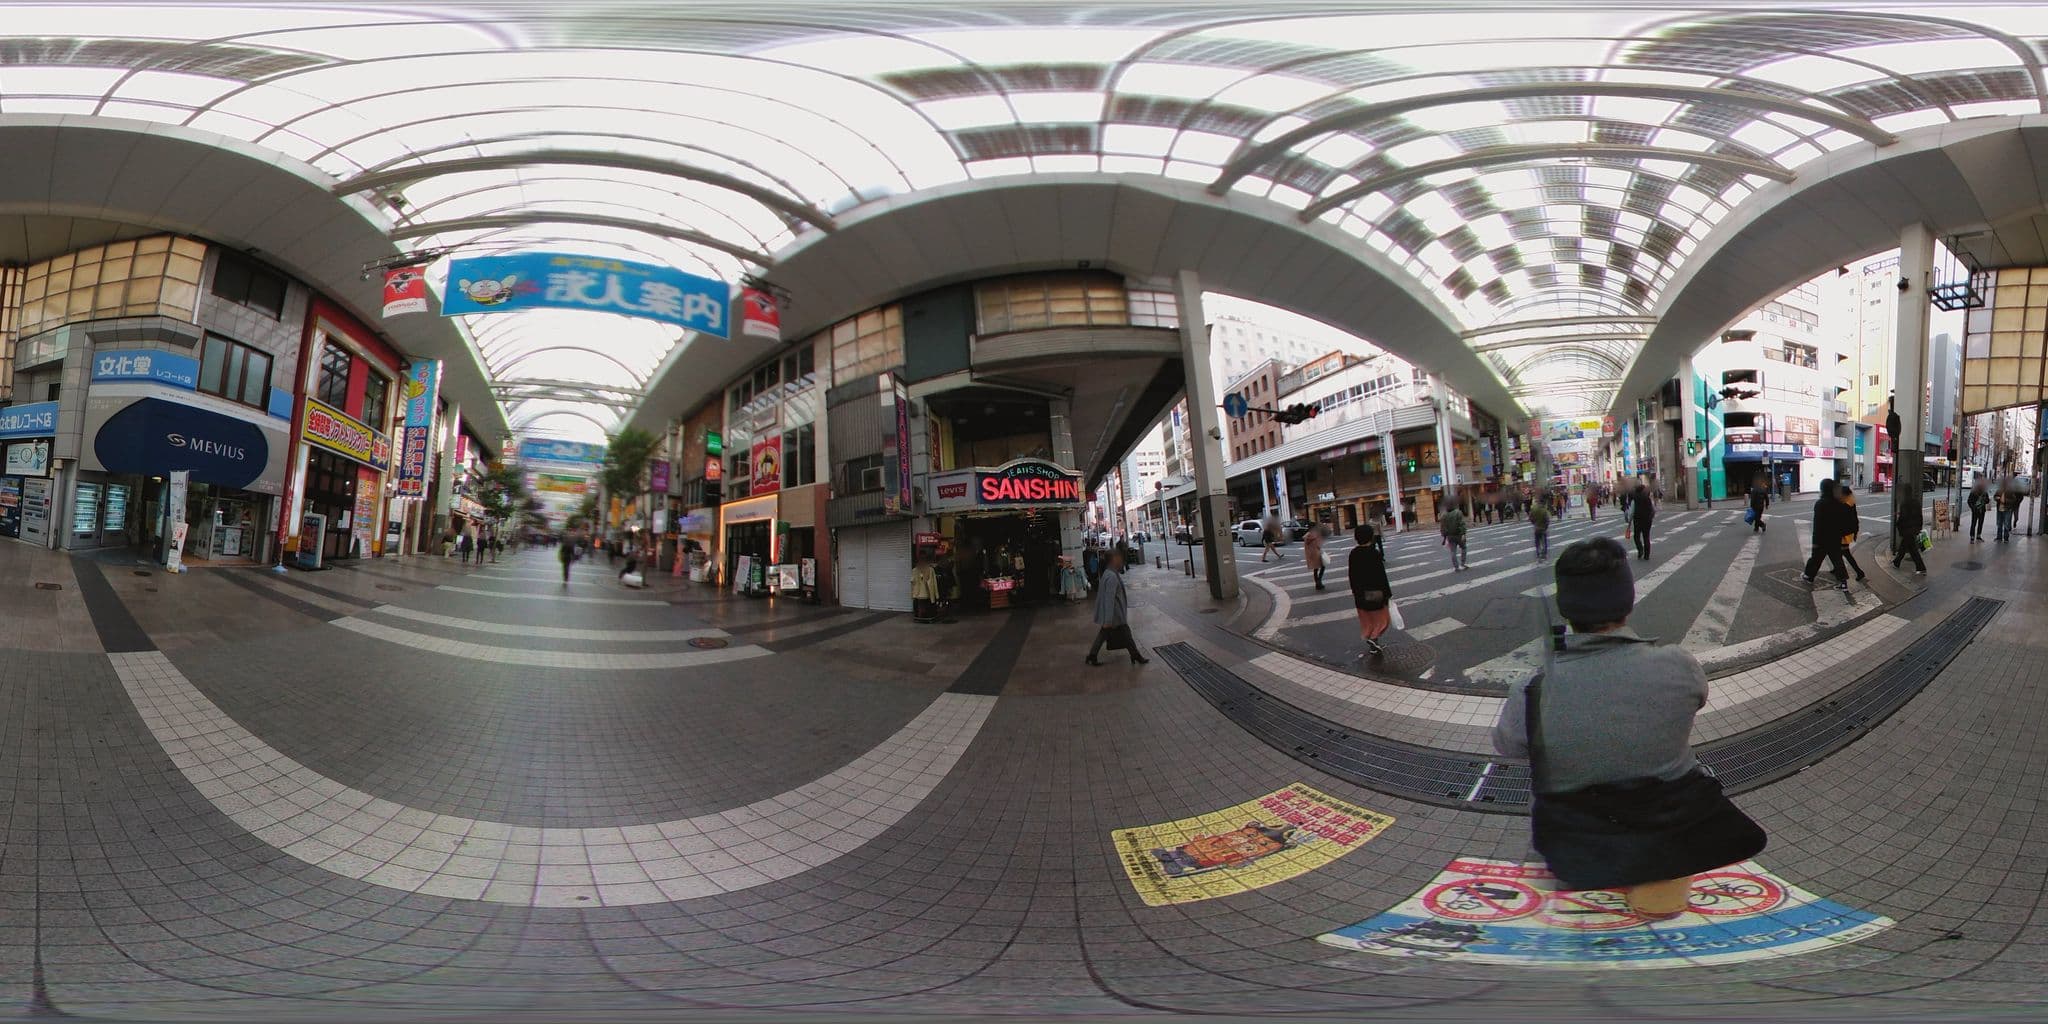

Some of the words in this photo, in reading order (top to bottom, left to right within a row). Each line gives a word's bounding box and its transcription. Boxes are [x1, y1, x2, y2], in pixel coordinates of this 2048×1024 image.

[98, 356, 152, 376] 文化堂
[156, 369, 192, 384] レコード店
[189, 437, 245, 461] MEVIUS
[1036, 466, 1060, 480] SHOP
[981, 476, 1079, 501] SANSHIN
[1259, 797, 1359, 846] 特別強化地域
[1276, 790, 1374, 835] 暴力団排除
